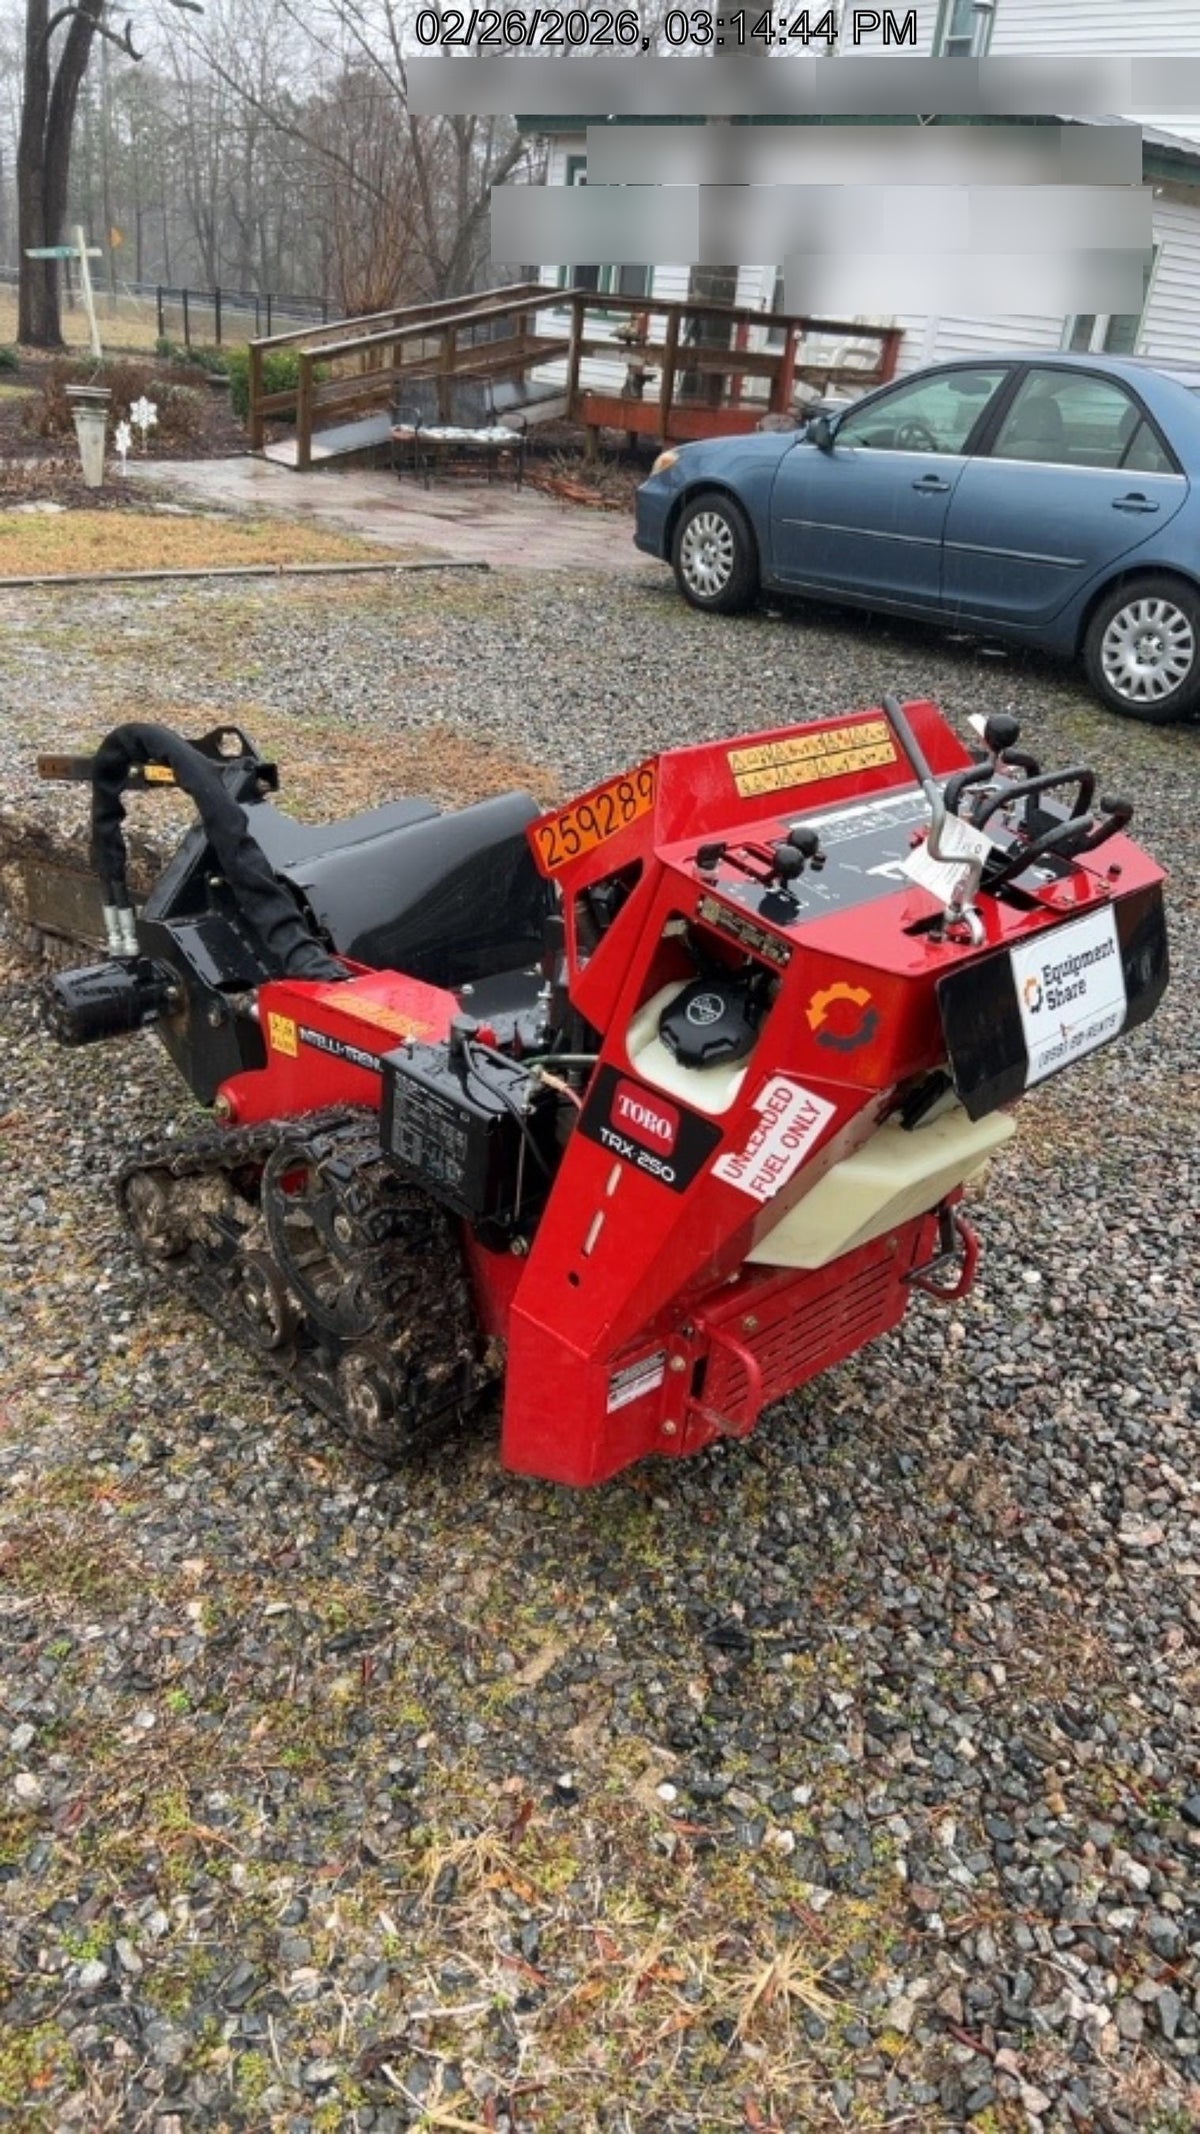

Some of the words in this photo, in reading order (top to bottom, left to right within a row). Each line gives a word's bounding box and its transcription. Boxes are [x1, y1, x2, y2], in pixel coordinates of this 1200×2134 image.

[539, 769, 654, 867] 259289
[1041, 938, 1116, 986] Equipment
[1045, 979, 1087, 1011] Share
[618, 1094, 673, 1141] TORO
[722, 1087, 793, 1179] UNLEADED
[749, 1153, 791, 1194] FUEL
[780, 1100, 821, 1149] ONLY
